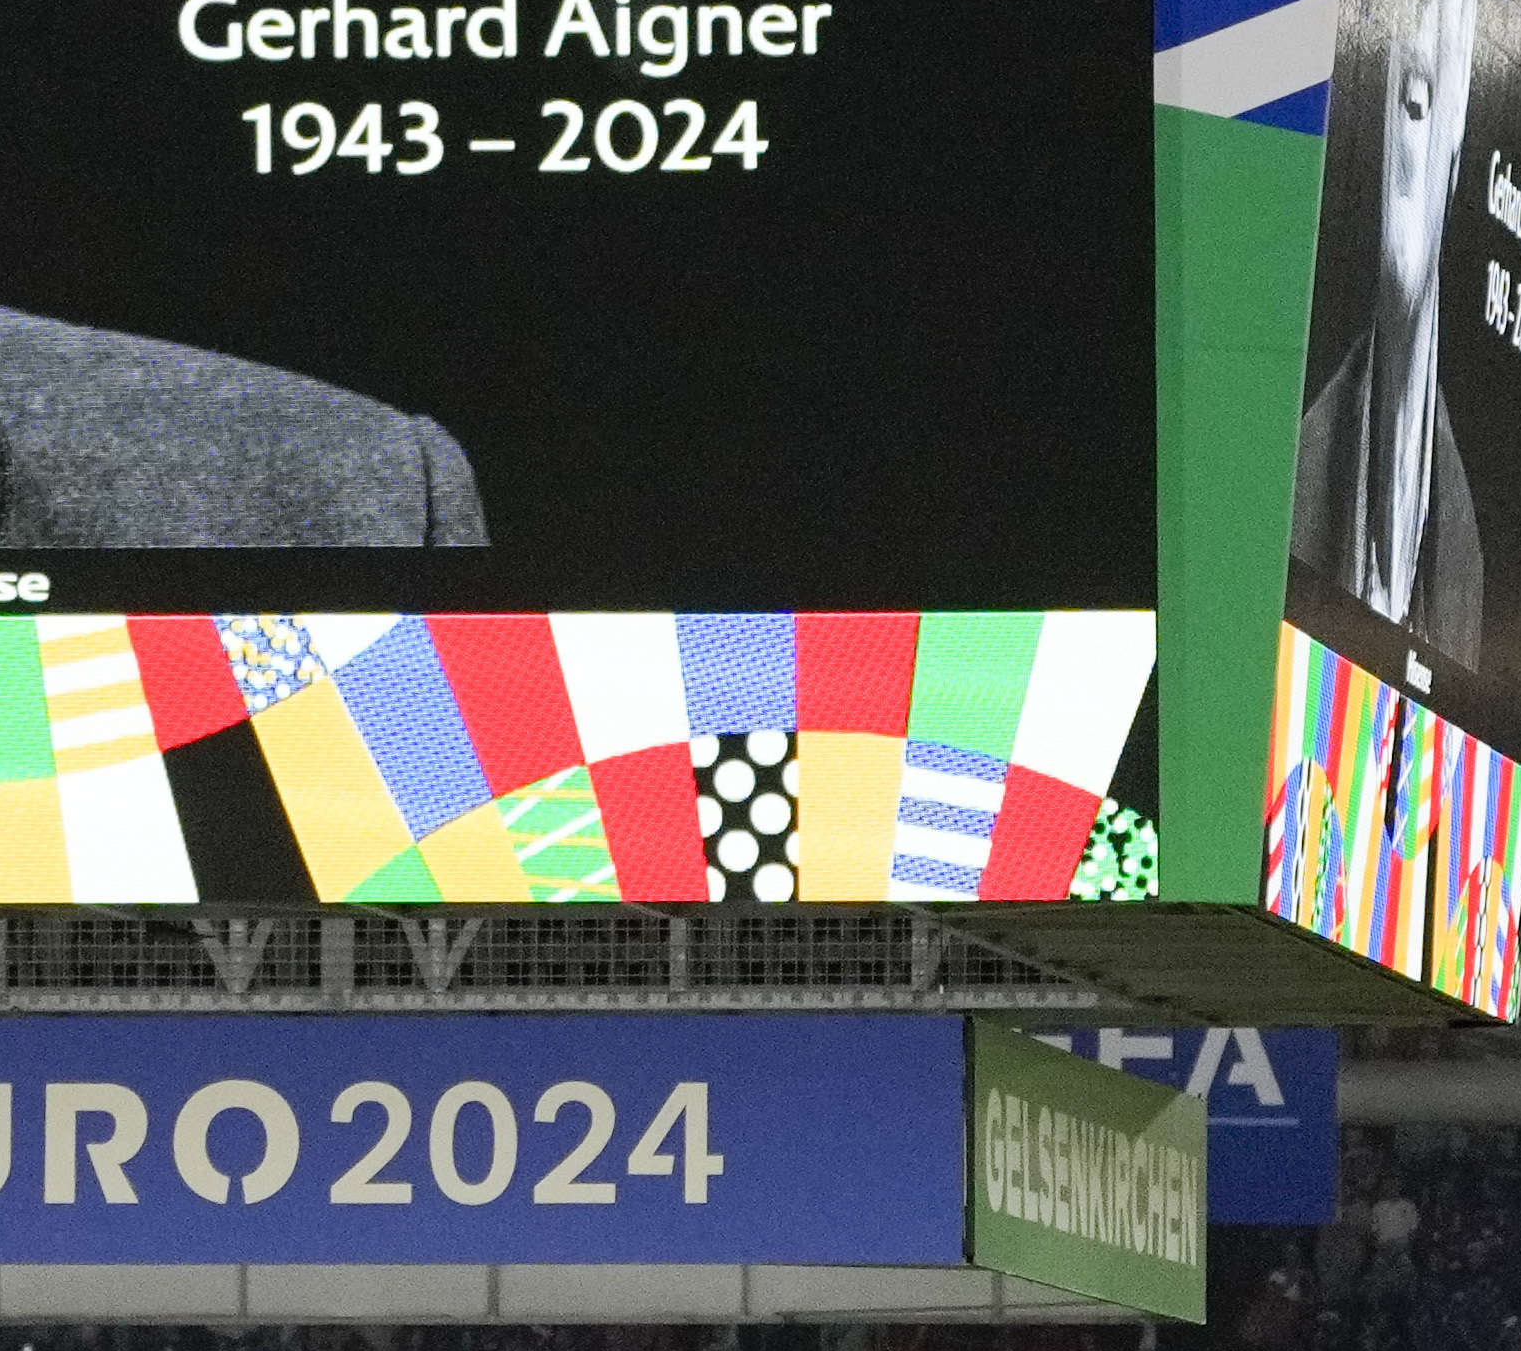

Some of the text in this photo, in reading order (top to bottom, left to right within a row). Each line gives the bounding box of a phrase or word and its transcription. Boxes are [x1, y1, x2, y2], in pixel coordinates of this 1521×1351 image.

[241, 101, 444, 175] 1943
[538, 99, 768, 174] 2024
[986, 1087, 1199, 1267] GELSENKIRCHEN
